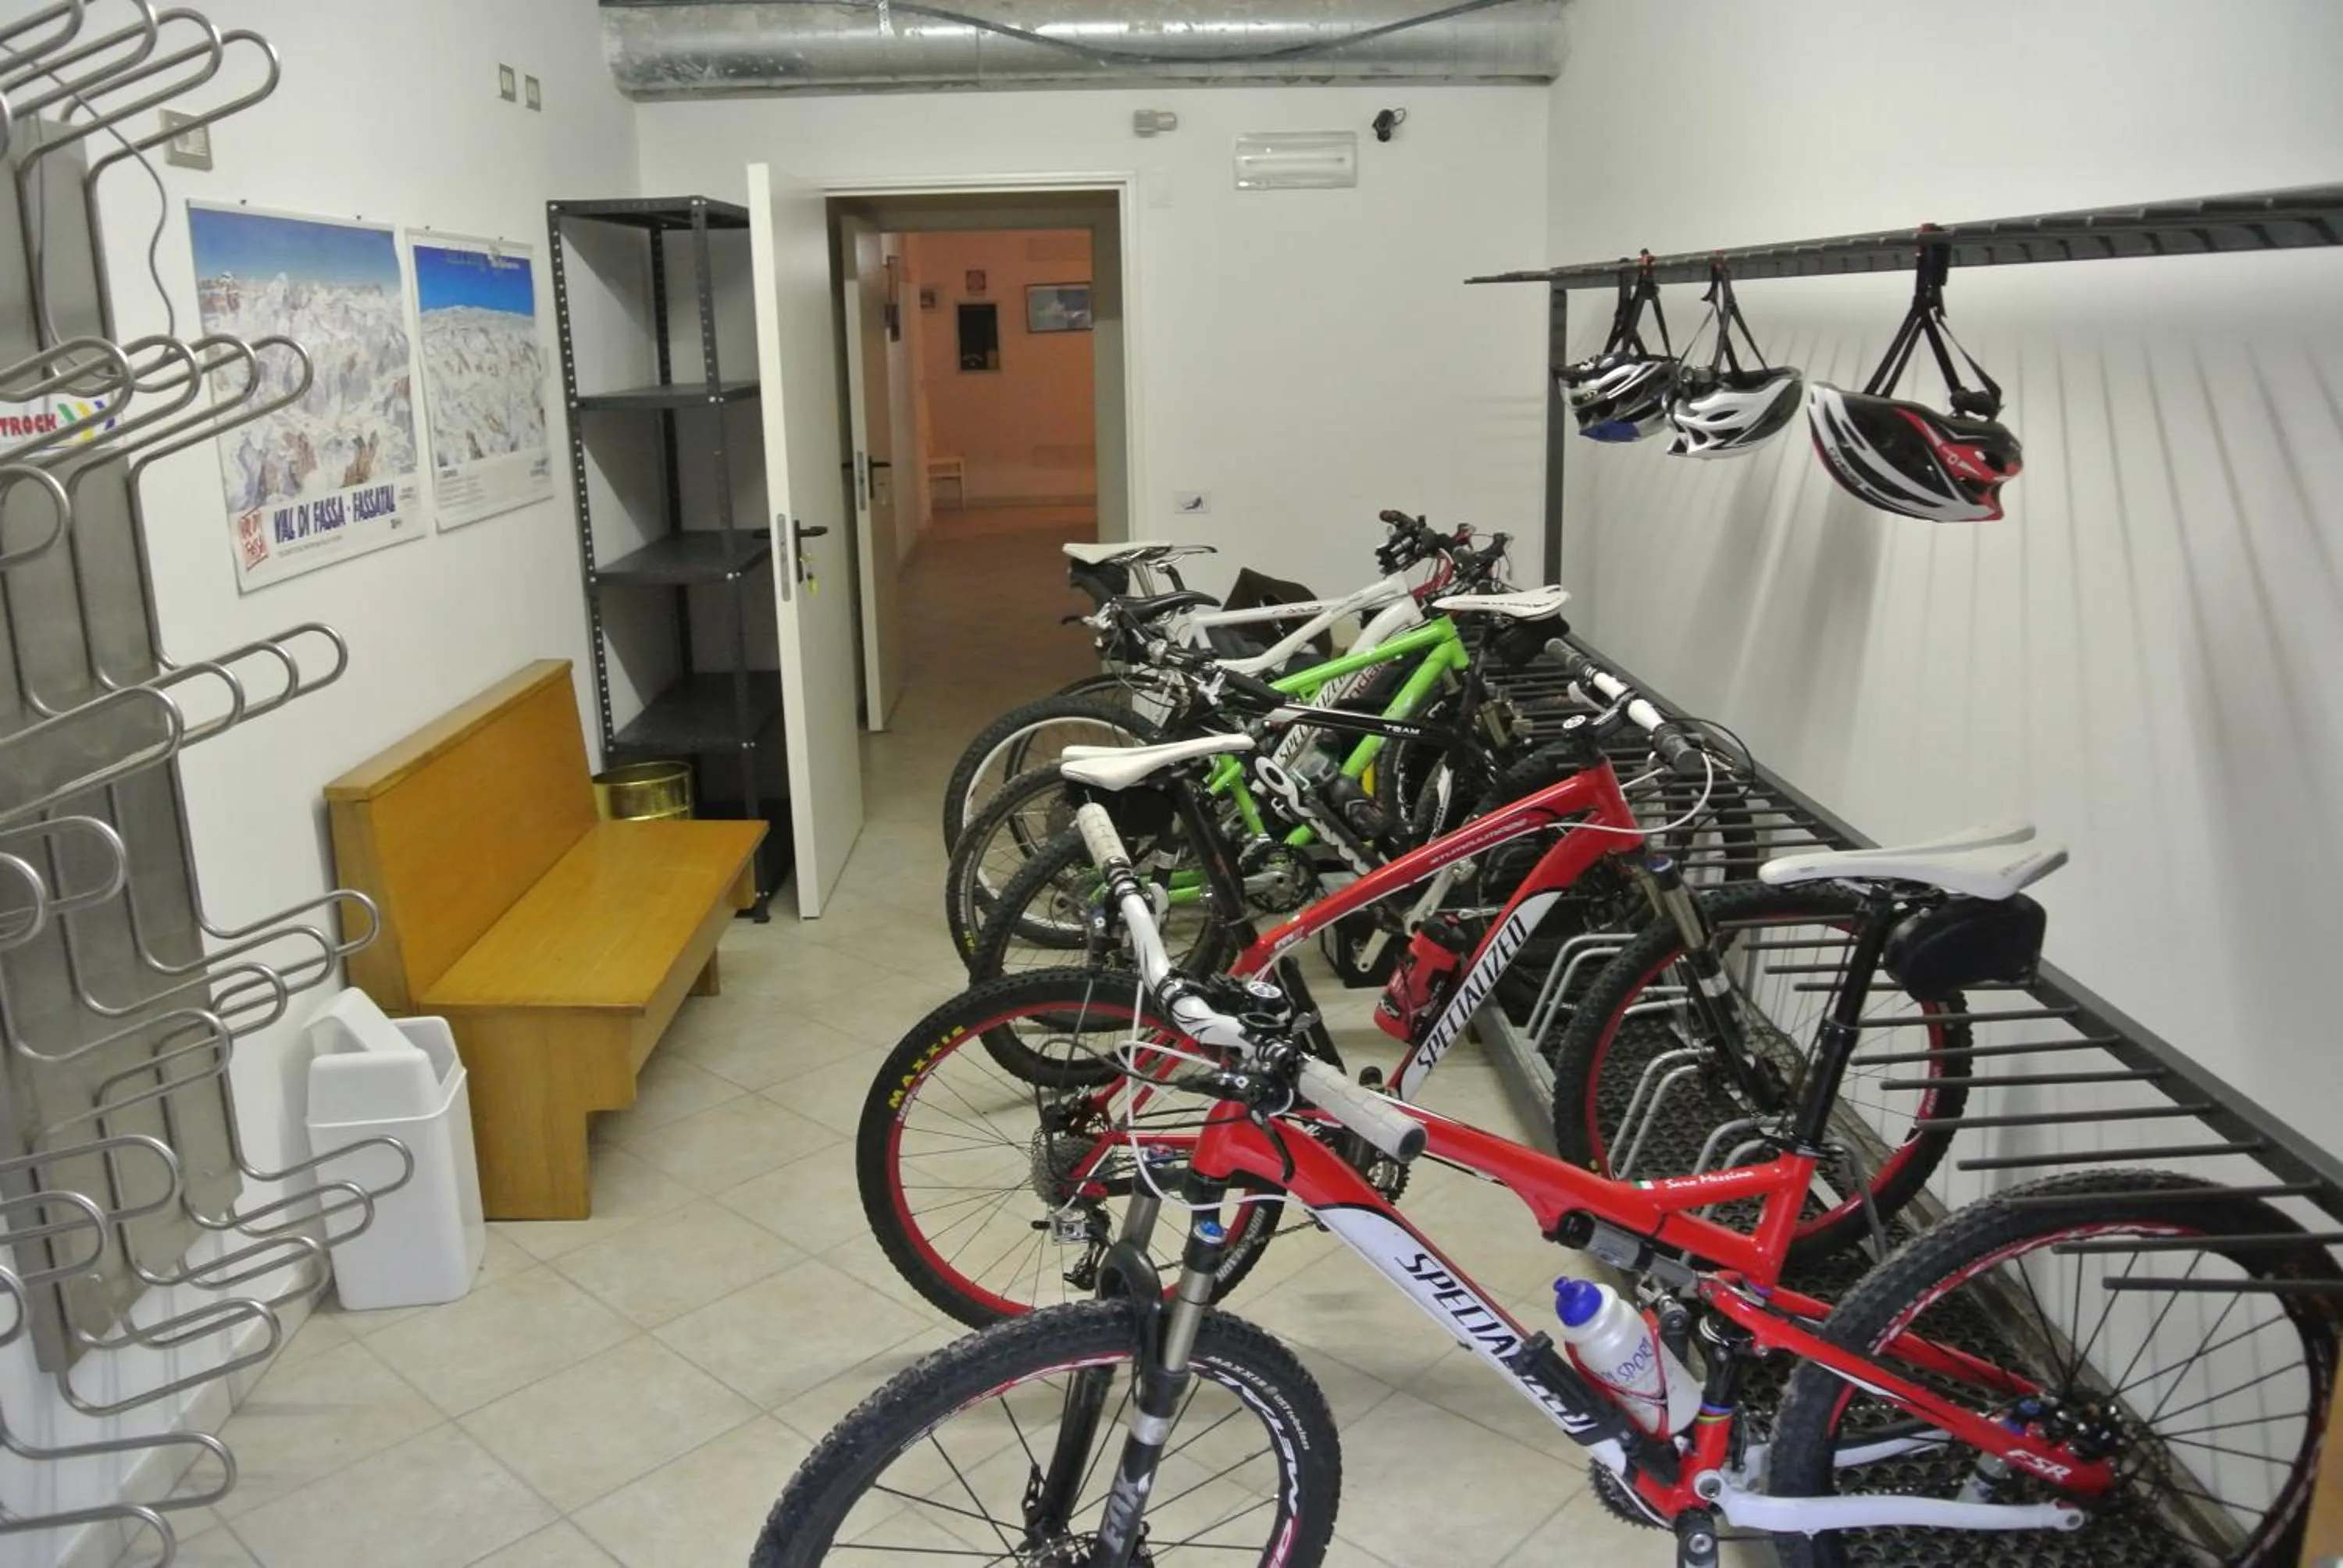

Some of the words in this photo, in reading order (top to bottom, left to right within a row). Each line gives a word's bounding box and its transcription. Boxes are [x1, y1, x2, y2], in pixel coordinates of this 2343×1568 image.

[275, 508, 295, 543] VAL
[298, 504, 310, 538] DI
[313, 495, 346, 533] FASSA
[1383, 724, 1421, 735] TEAM
[1417, 914, 1528, 1071] SPECIALIZED
[888, 1025, 966, 1109] MAXXIS
[1394, 1253, 1598, 1427] SPECIA
[2005, 1449, 2073, 1481] FSR
